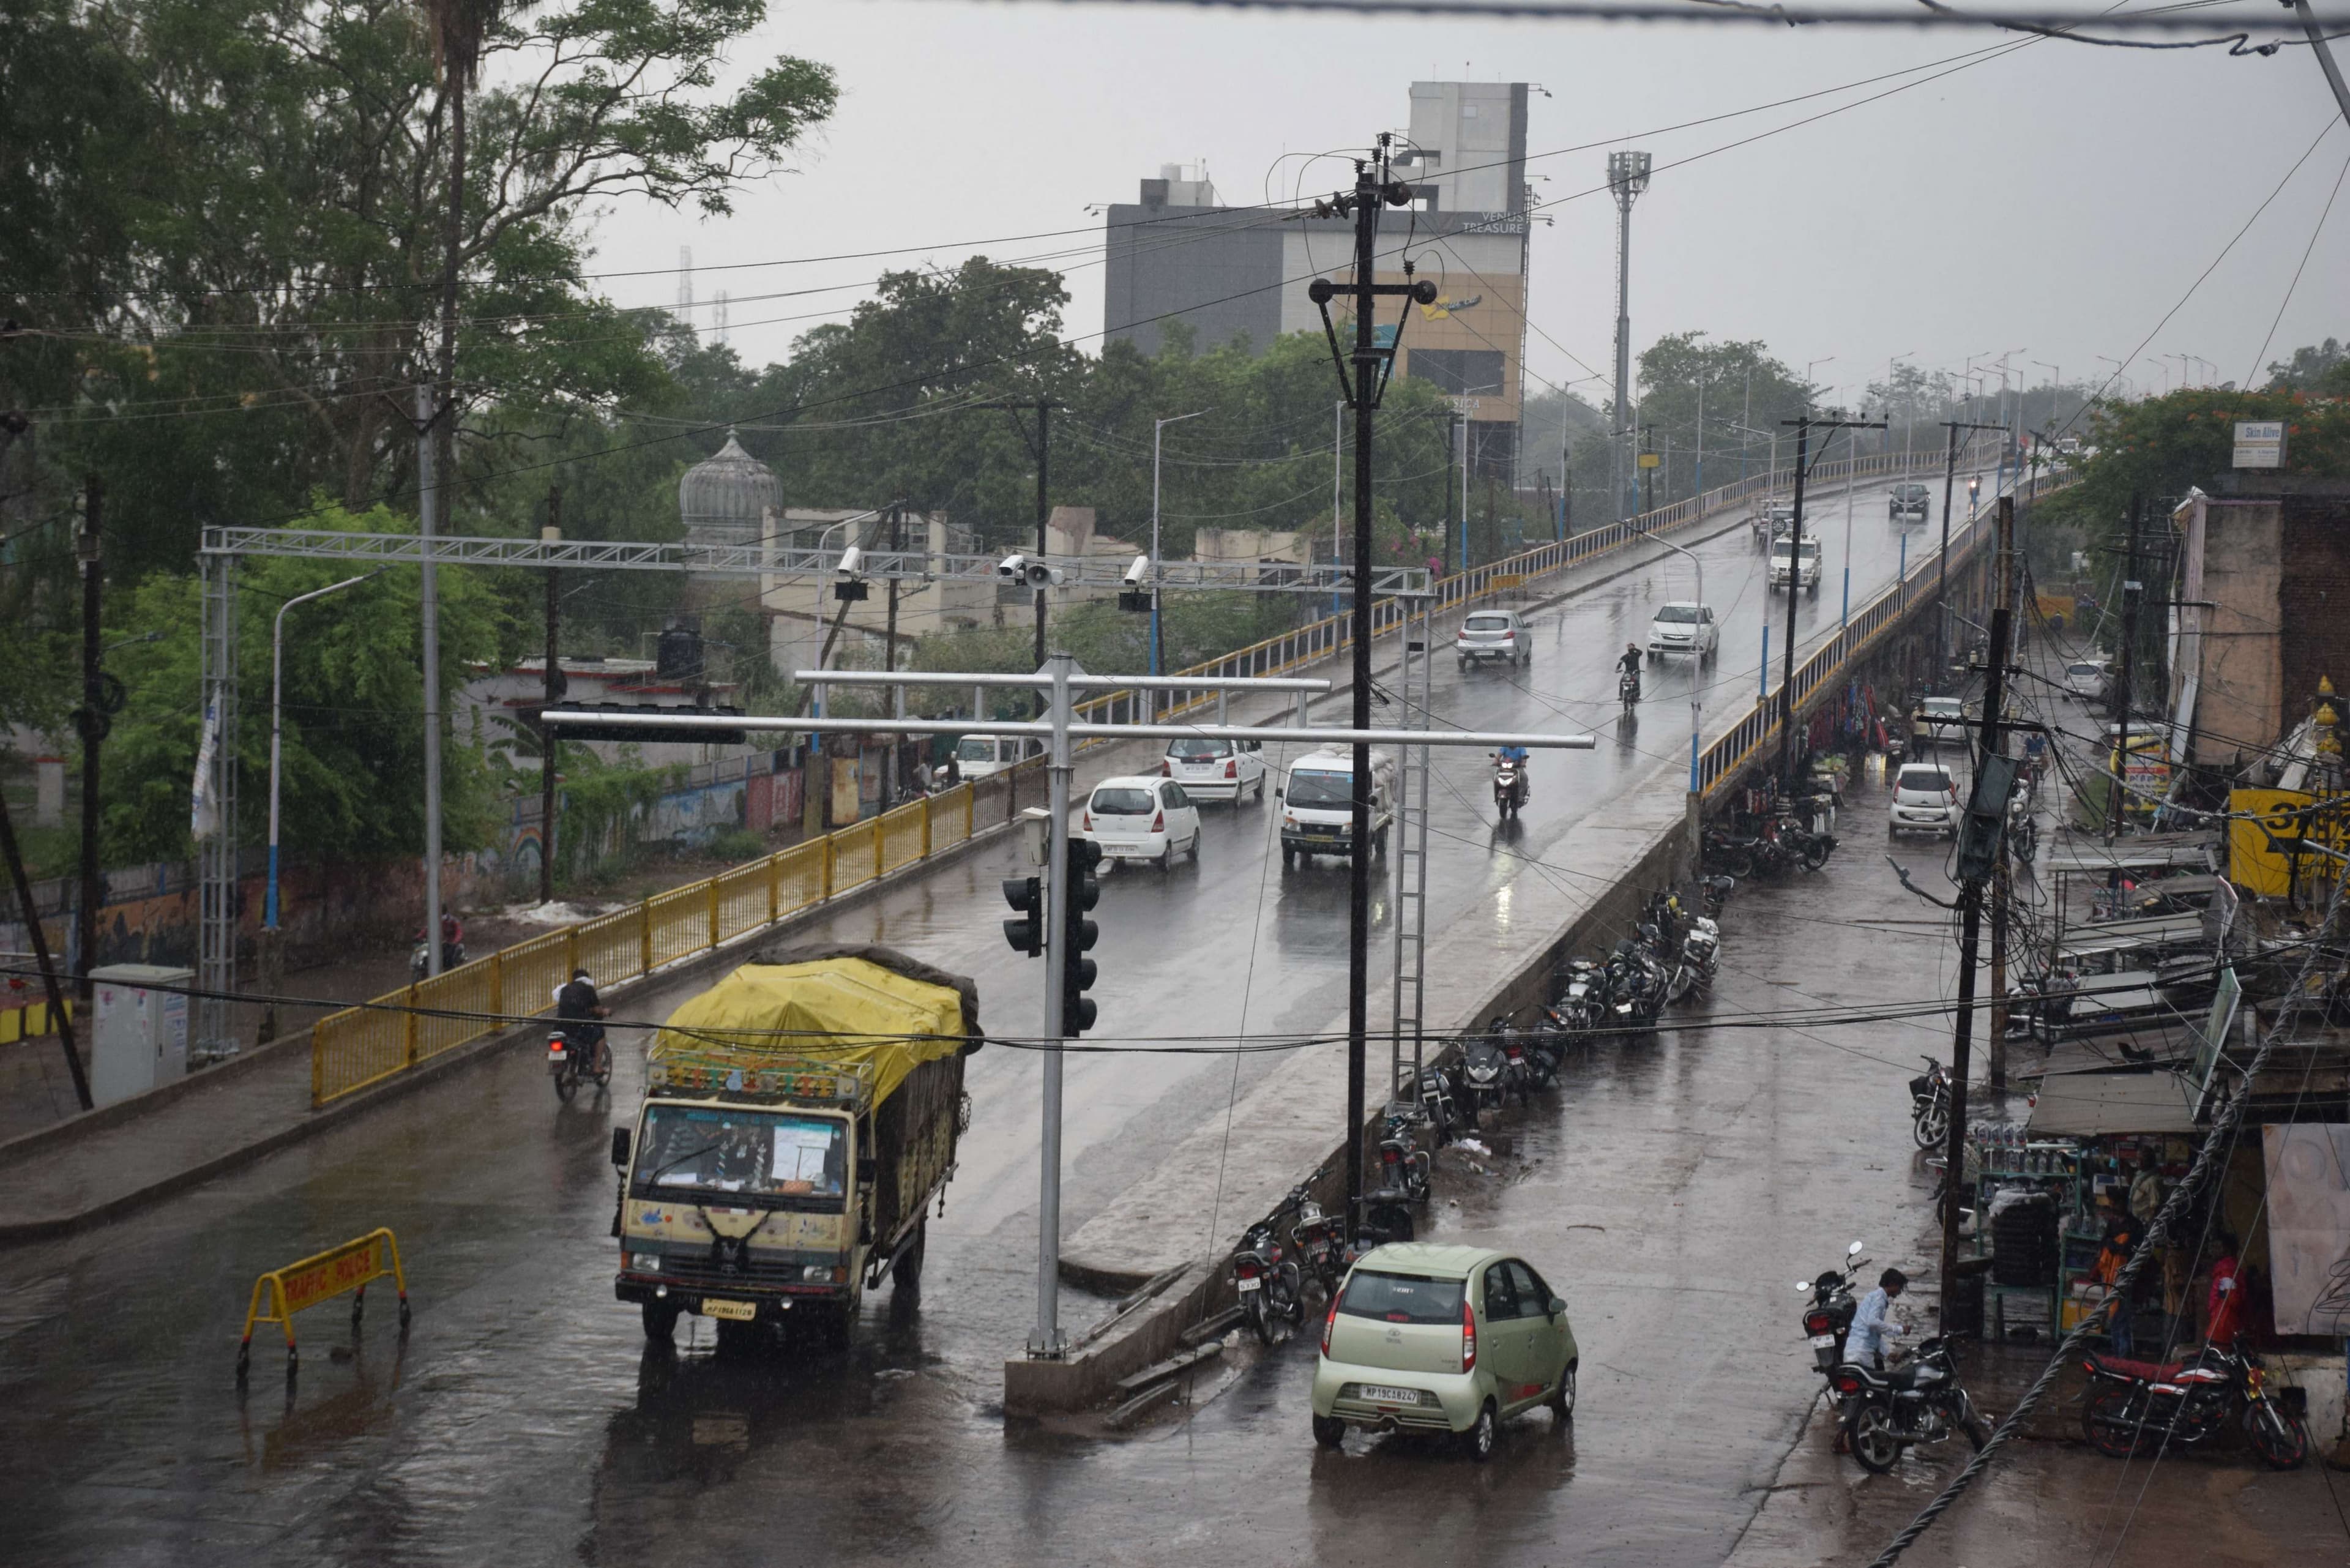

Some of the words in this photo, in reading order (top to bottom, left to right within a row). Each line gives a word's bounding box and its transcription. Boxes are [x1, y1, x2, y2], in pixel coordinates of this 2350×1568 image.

[1482, 212, 1523, 222] VENUS
[1463, 223, 1523, 233] TREASURE
[2245, 427, 2261, 438] Skin
[2262, 427, 2280, 438] Alive
[336, 1250, 370, 1282] POLICE
